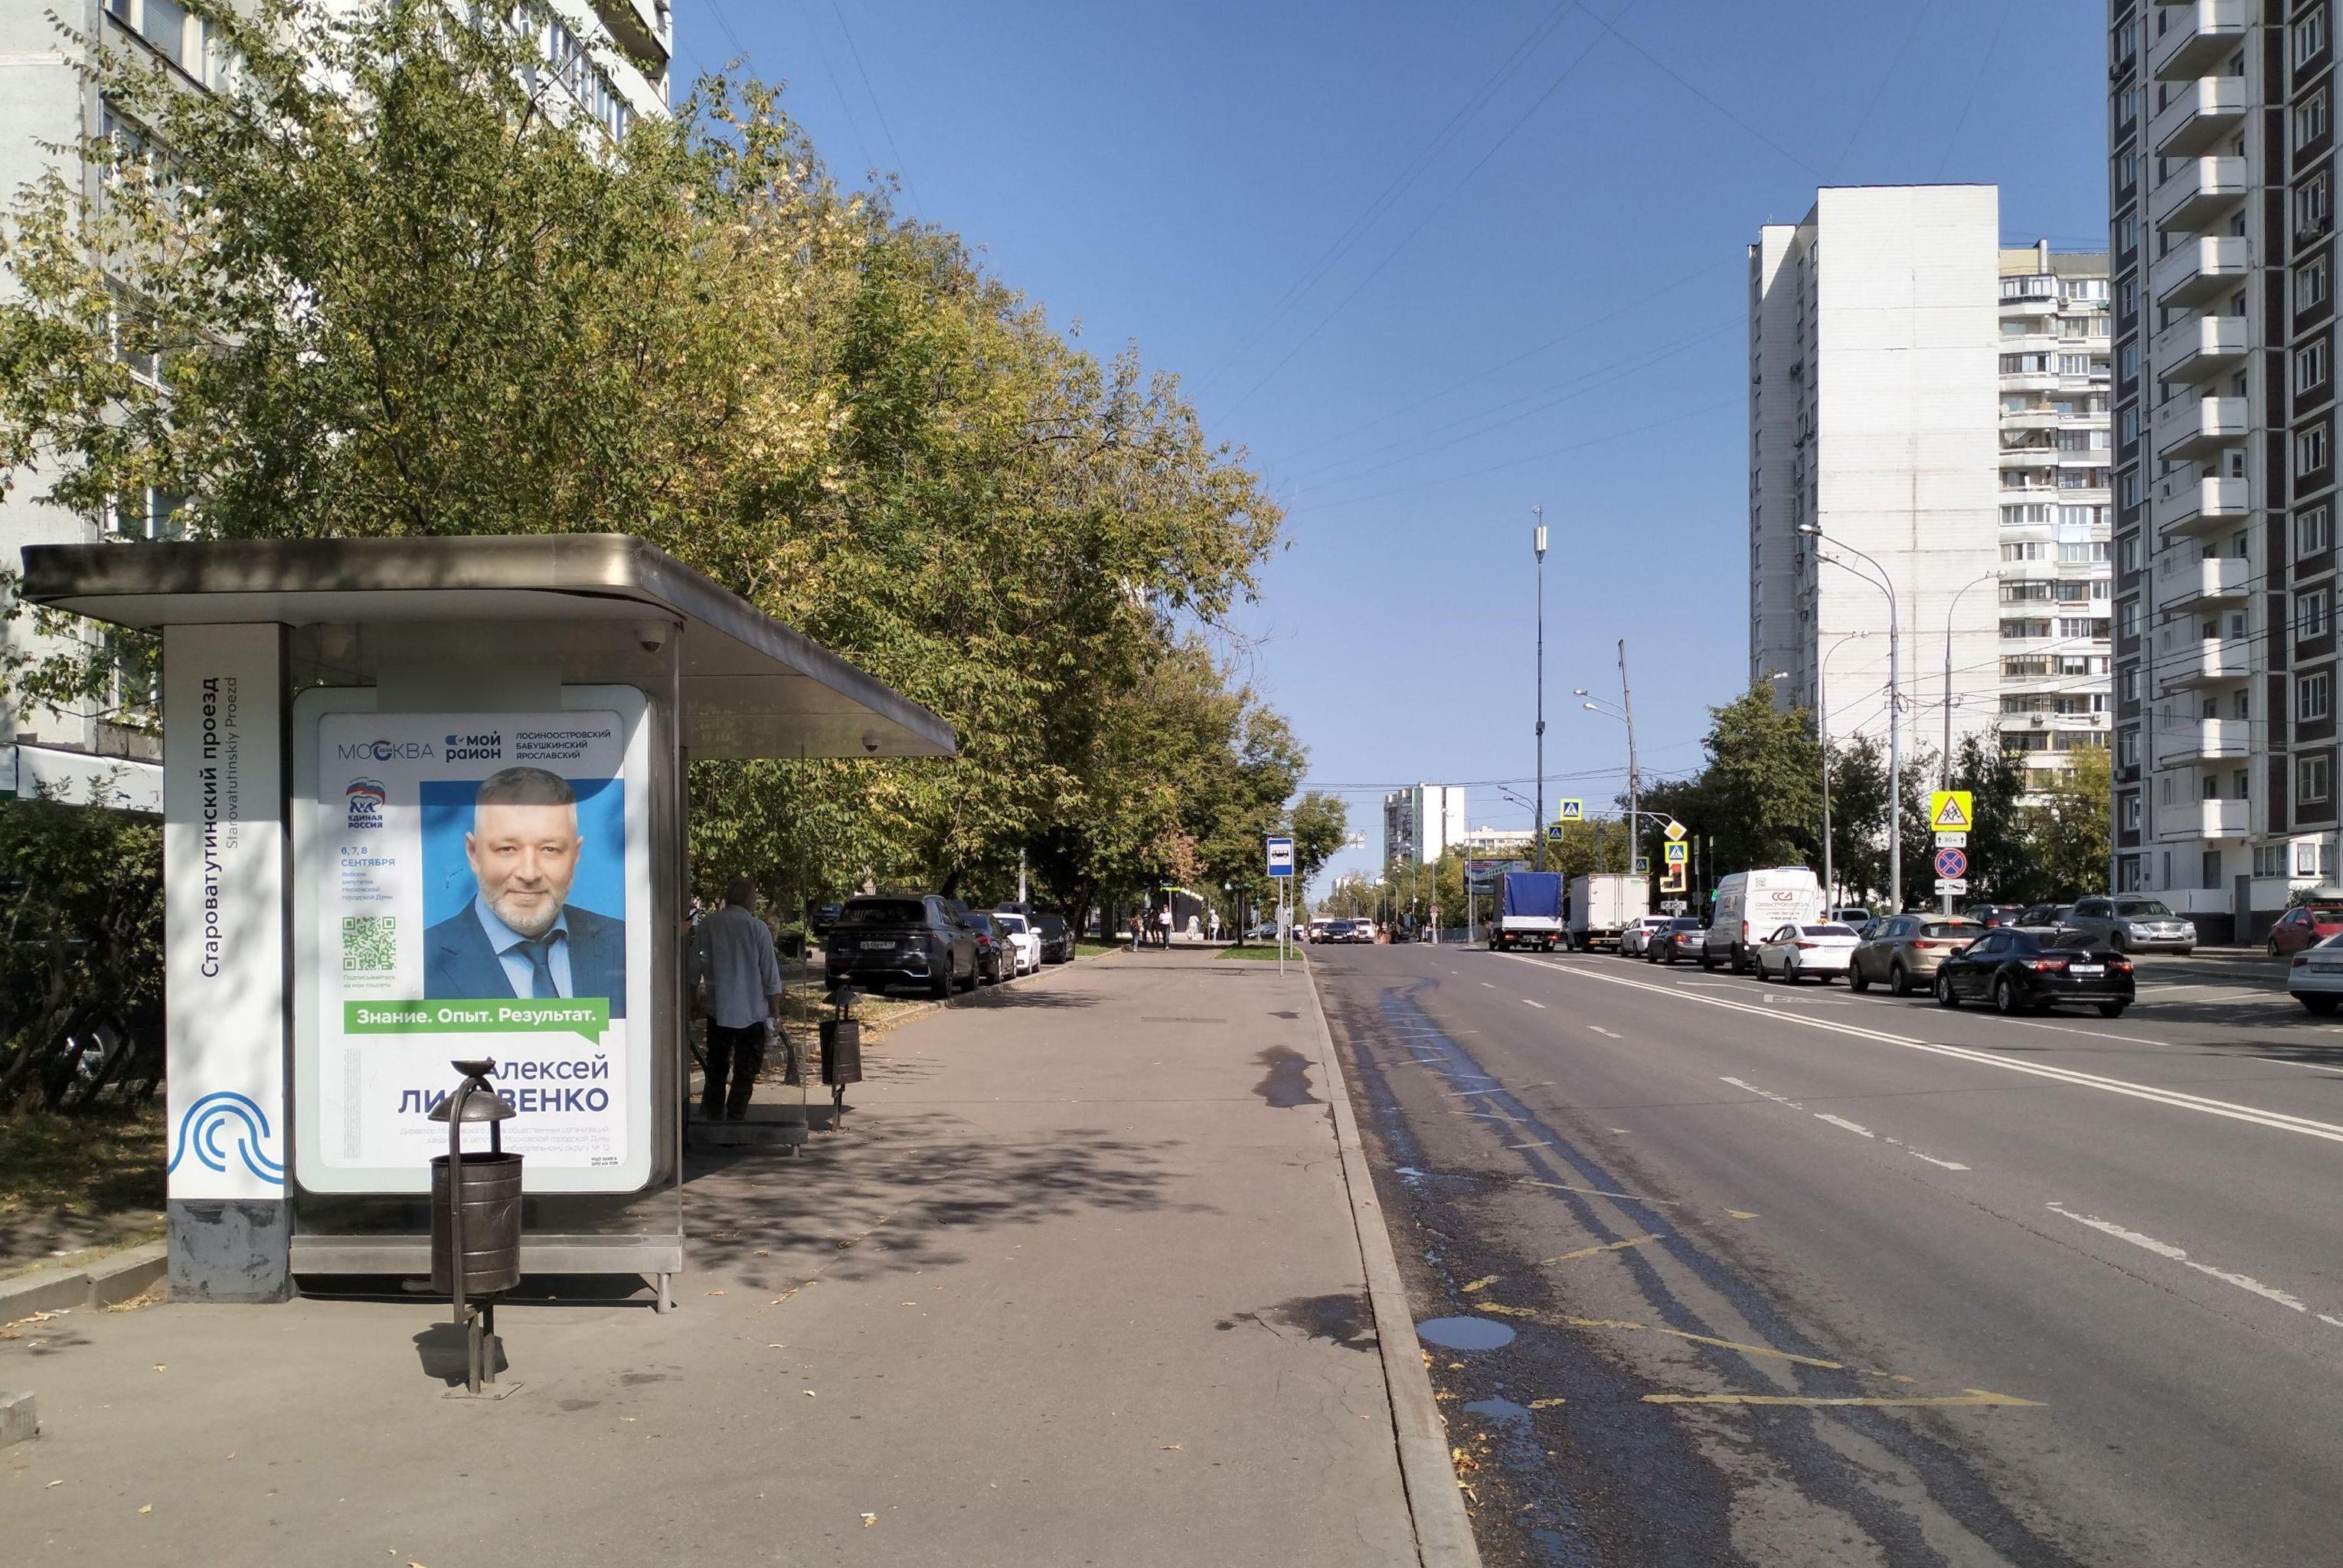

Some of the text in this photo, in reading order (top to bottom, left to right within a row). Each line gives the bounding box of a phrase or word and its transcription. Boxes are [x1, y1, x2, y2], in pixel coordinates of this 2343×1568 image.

[515, 730, 612, 740] ЛОСИНООСТРОВСКИЙ
[338, 740, 435, 761] МОСКВА
[515, 740, 588, 750] БАБУШКИНСКИЙ
[515, 750, 581, 760] ЯРОСЛАВСКИЙ
[224, 677, 240, 849] Starovatutinskiy Proezd
[200, 677, 223, 978] Староватутинский проезд
[341, 847, 350, 855] 6,
[341, 858, 395, 867] СЕНТЯБРЯ
[357, 1007, 597, 1026] Знание. Опыт. Результат.
[397, 1088, 609, 1113] ЛИВЕНКО
